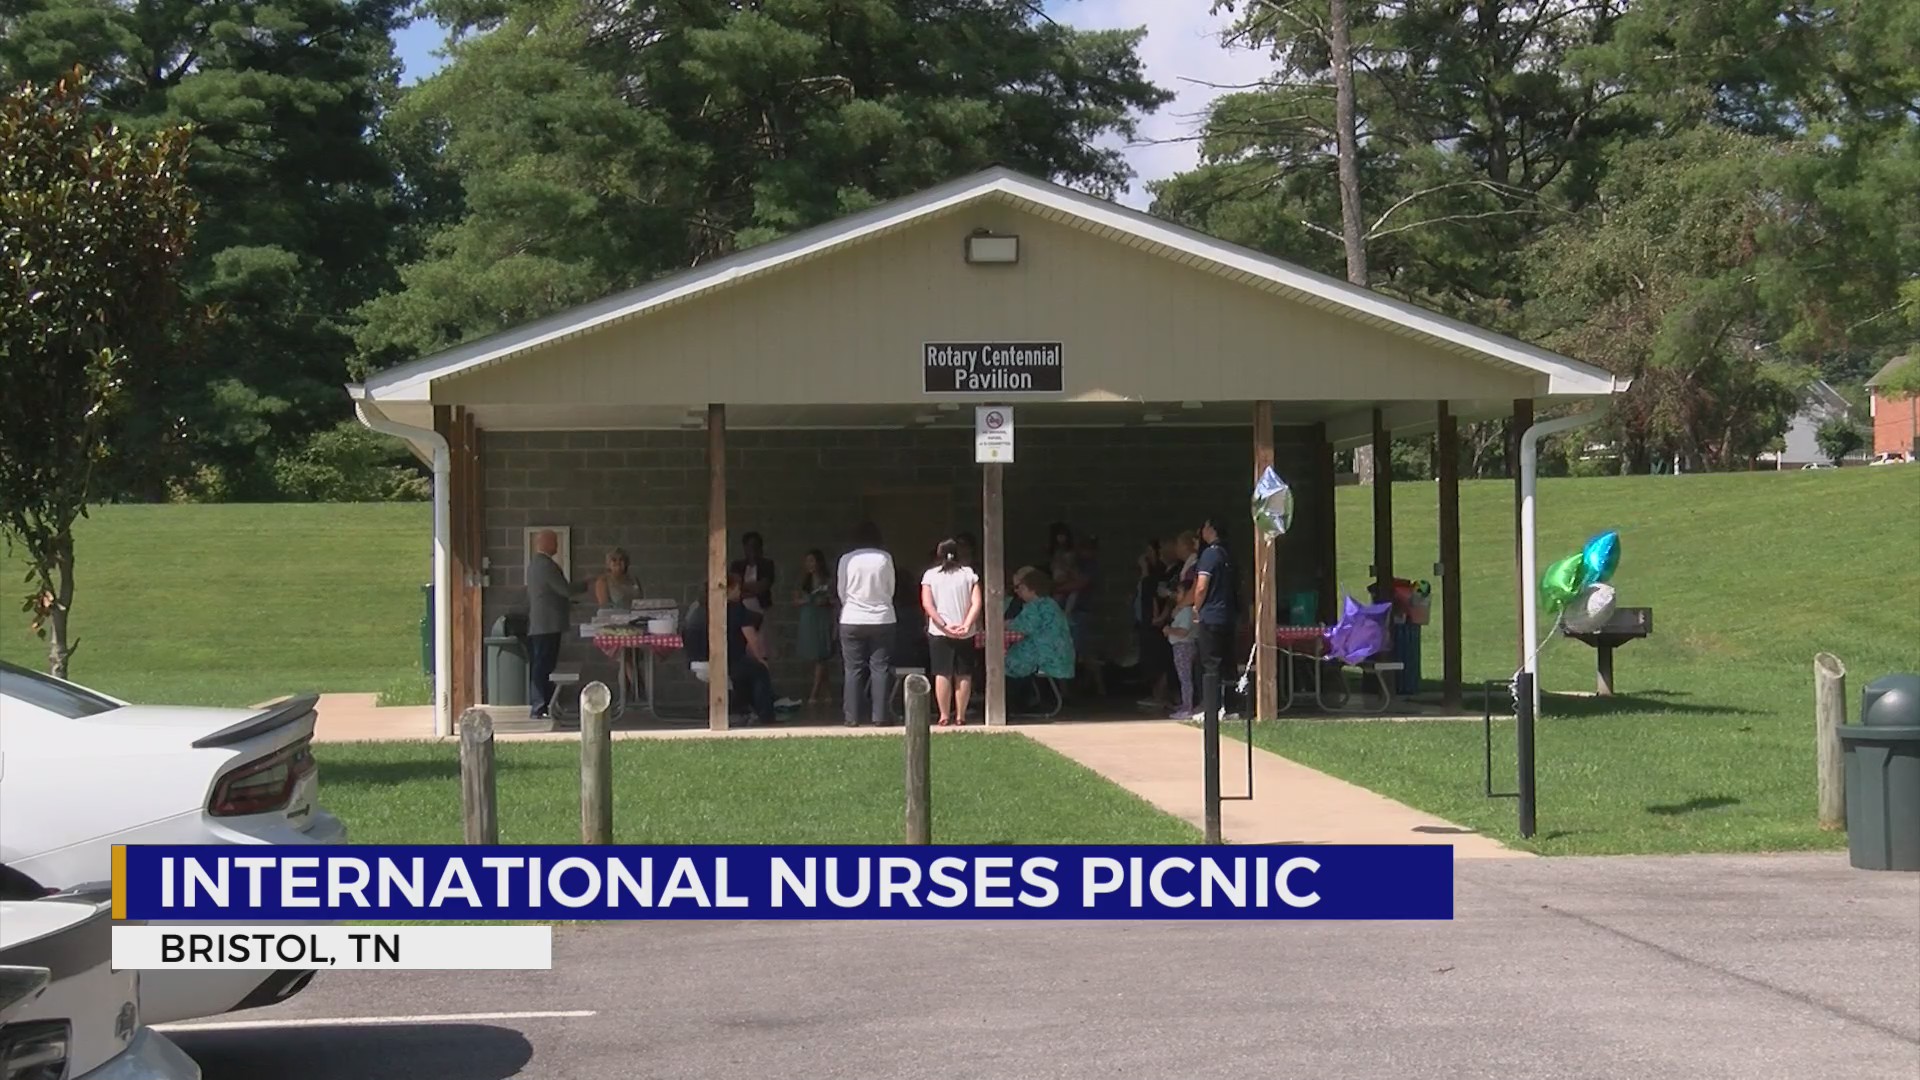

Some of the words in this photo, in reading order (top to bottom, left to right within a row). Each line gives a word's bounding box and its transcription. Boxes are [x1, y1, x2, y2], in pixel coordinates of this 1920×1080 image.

[928, 346, 977, 372] Rotary
[982, 346, 1059, 366] Centennial
[955, 369, 1032, 389] Pavilion
